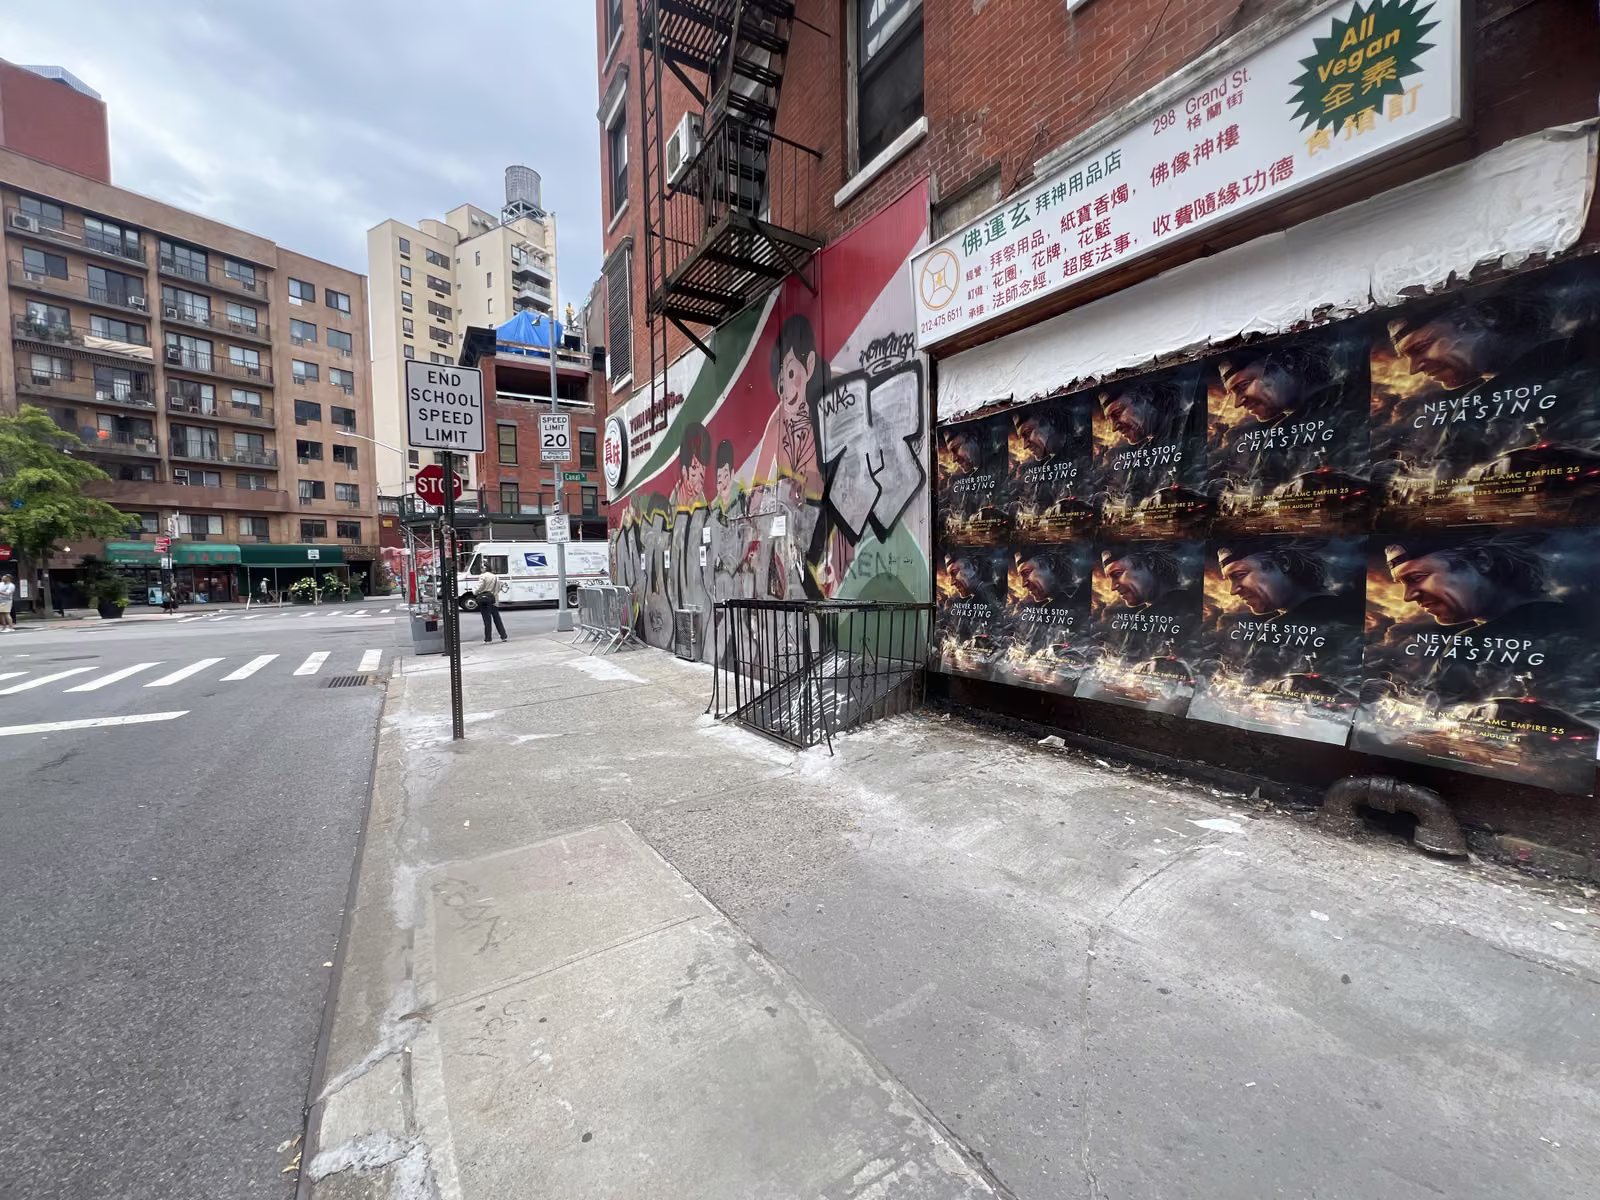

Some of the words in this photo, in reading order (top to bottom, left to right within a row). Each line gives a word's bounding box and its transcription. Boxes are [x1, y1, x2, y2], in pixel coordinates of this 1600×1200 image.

[1339, 13, 1375, 52] All
[1317, 29, 1400, 83] Vegan
[1321, 56, 1397, 115] 全素
[1153, 109, 1176, 136] 298
[1185, 79, 1227, 114] Grand
[1232, 68, 1252, 89] St.
[1187, 90, 1243, 131] 格蘭街
[1150, 124, 1240, 187] 佛像神樓
[962, 199, 1031, 257] 佛運玄
[1035, 149, 1122, 215] 拜神用品店
[947, 305, 963, 322] 6511
[428, 370, 461, 387] END
[411, 388, 479, 408] SCHOOL
[1424, 395, 1482, 415] NEVER
[1492, 384, 1543, 403] STOP
[418, 408, 473, 425] SPEED
[1413, 394, 1557, 429] CHASING
[542, 416, 567, 424] SPEED
[425, 427, 467, 443] LIMIT
[1244, 427, 1285, 441] NEVER
[1291, 420, 1325, 434] STOP
[543, 433, 567, 447] 20
[1236, 429, 1334, 453] CHASING
[1119, 449, 1148, 460] NEVER
[1151, 444, 1176, 455] STOP
[1028, 466, 1050, 475] NEVER
[1053, 461, 1073, 471] STOP
[1114, 452, 1182, 471] CHASING
[957, 477, 975, 485] NEVER
[976, 474, 991, 483] STOP
[1024, 468, 1077, 483] CHASING
[1498, 472, 1522, 480] AMC
[1525, 468, 1563, 477] EMPIRE
[1566, 466, 1580, 474] 25
[953, 480, 995, 493] CHASING
[1494, 486, 1525, 494] AUGUST
[950, 608, 992, 618] CHASING
[953, 602, 971, 611] NEVER
[1026, 607, 1050, 616] NEVER
[1051, 608, 1068, 616] STOP
[1021, 613, 1074, 626] CHASING
[1117, 613, 1146, 623] NEVER
[1149, 615, 1174, 624] STOP
[1111, 620, 1182, 634] CHASING
[1238, 621, 1277, 633] NEVER
[1283, 624, 1317, 635] STOP
[1230, 630, 1326, 648] CHASING
[1416, 633, 1473, 647] NEVER
[1483, 637, 1532, 650] STOP
[1405, 643, 1545, 666] CHASING
[1484, 719, 1507, 727] AMC
[1511, 721, 1548, 733] EMPIRE
[1551, 727, 1565, 735] 25
[1479, 732, 1510, 742] AUGUST
